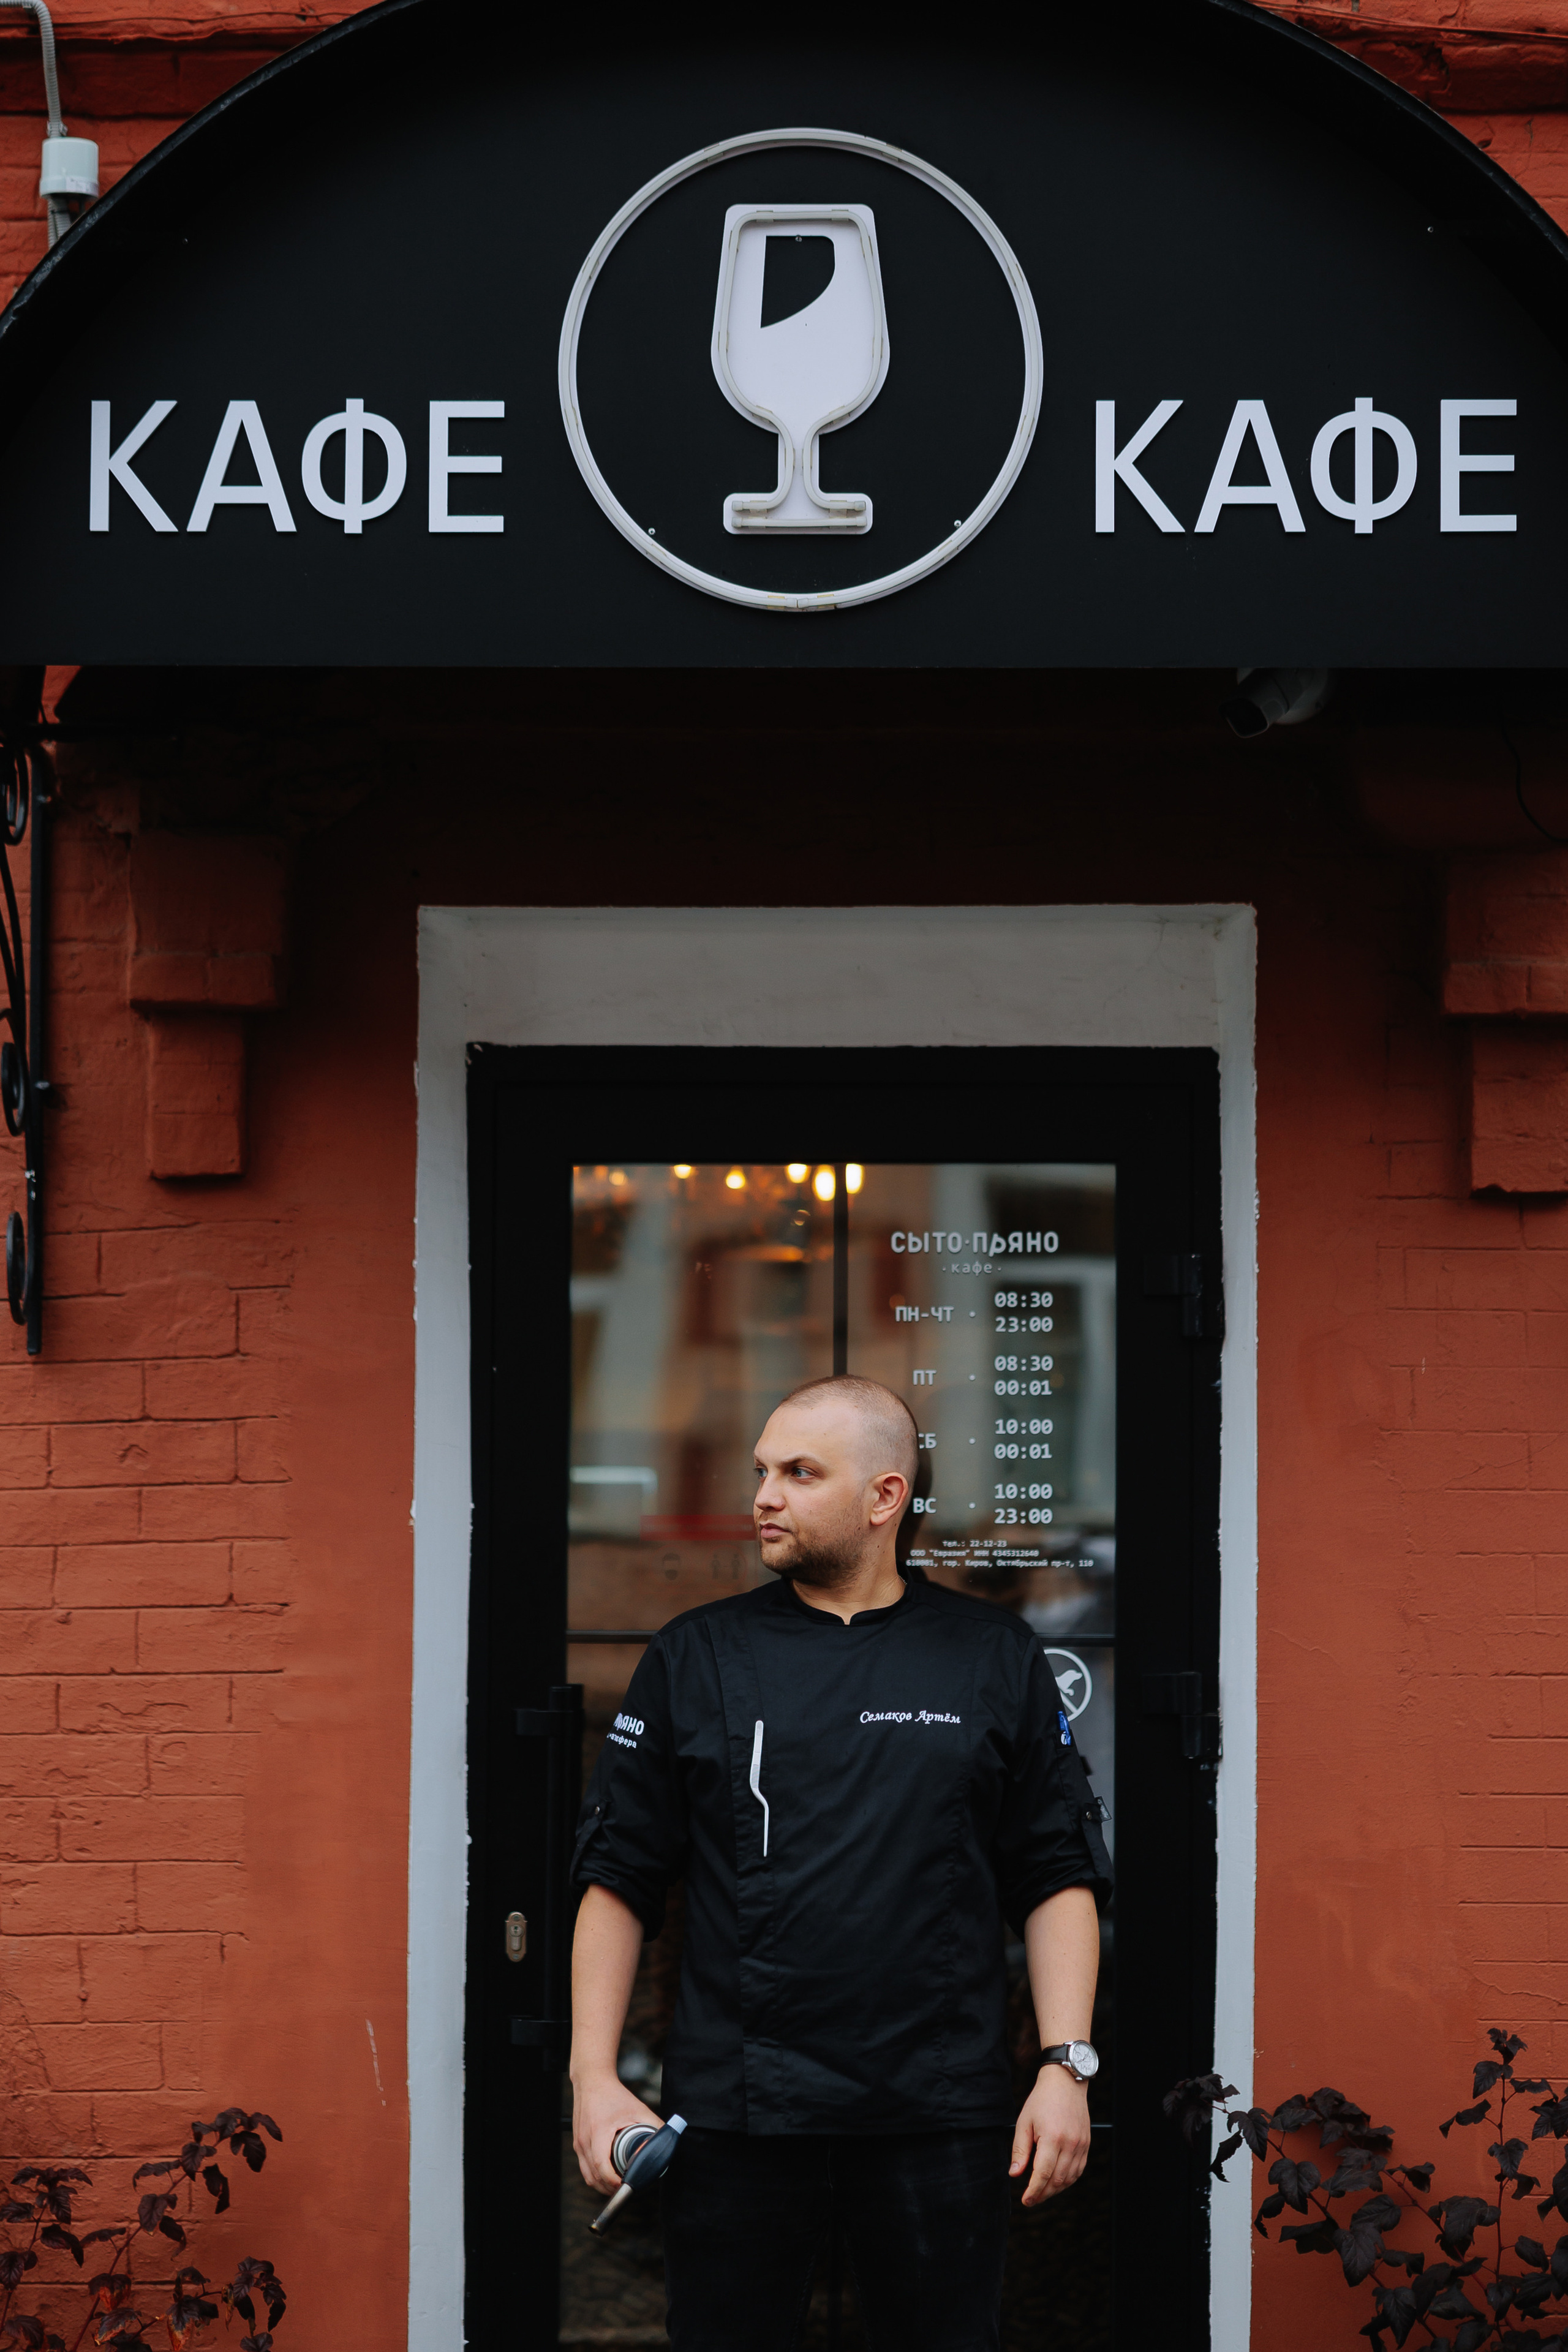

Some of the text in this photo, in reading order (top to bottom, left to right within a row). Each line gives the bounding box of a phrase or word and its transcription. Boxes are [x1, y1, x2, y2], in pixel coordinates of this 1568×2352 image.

[89, 398, 505, 534] КАФЕ
[1095, 397, 1517, 534] КАФЕ
[951, 1260, 992, 1276] кафе
[994, 1292, 1053, 1308] 08:30
[895, 1306, 954, 1322] ПН-ЧТ
[995, 1316, 1053, 1333] 23:00
[994, 1355, 1053, 1371] 08:30
[913, 1369, 937, 1385] ПТ
[994, 1380, 1052, 1396] 00:01
[995, 1419, 1053, 1434] 10:00
[994, 1443, 1052, 1459] 00:01
[994, 1483, 1052, 1499] 10:00
[913, 1498, 937, 1514] ВС
[994, 1508, 1053, 1524] 23:00
[859, 1709, 961, 1725] Семаков Артём
